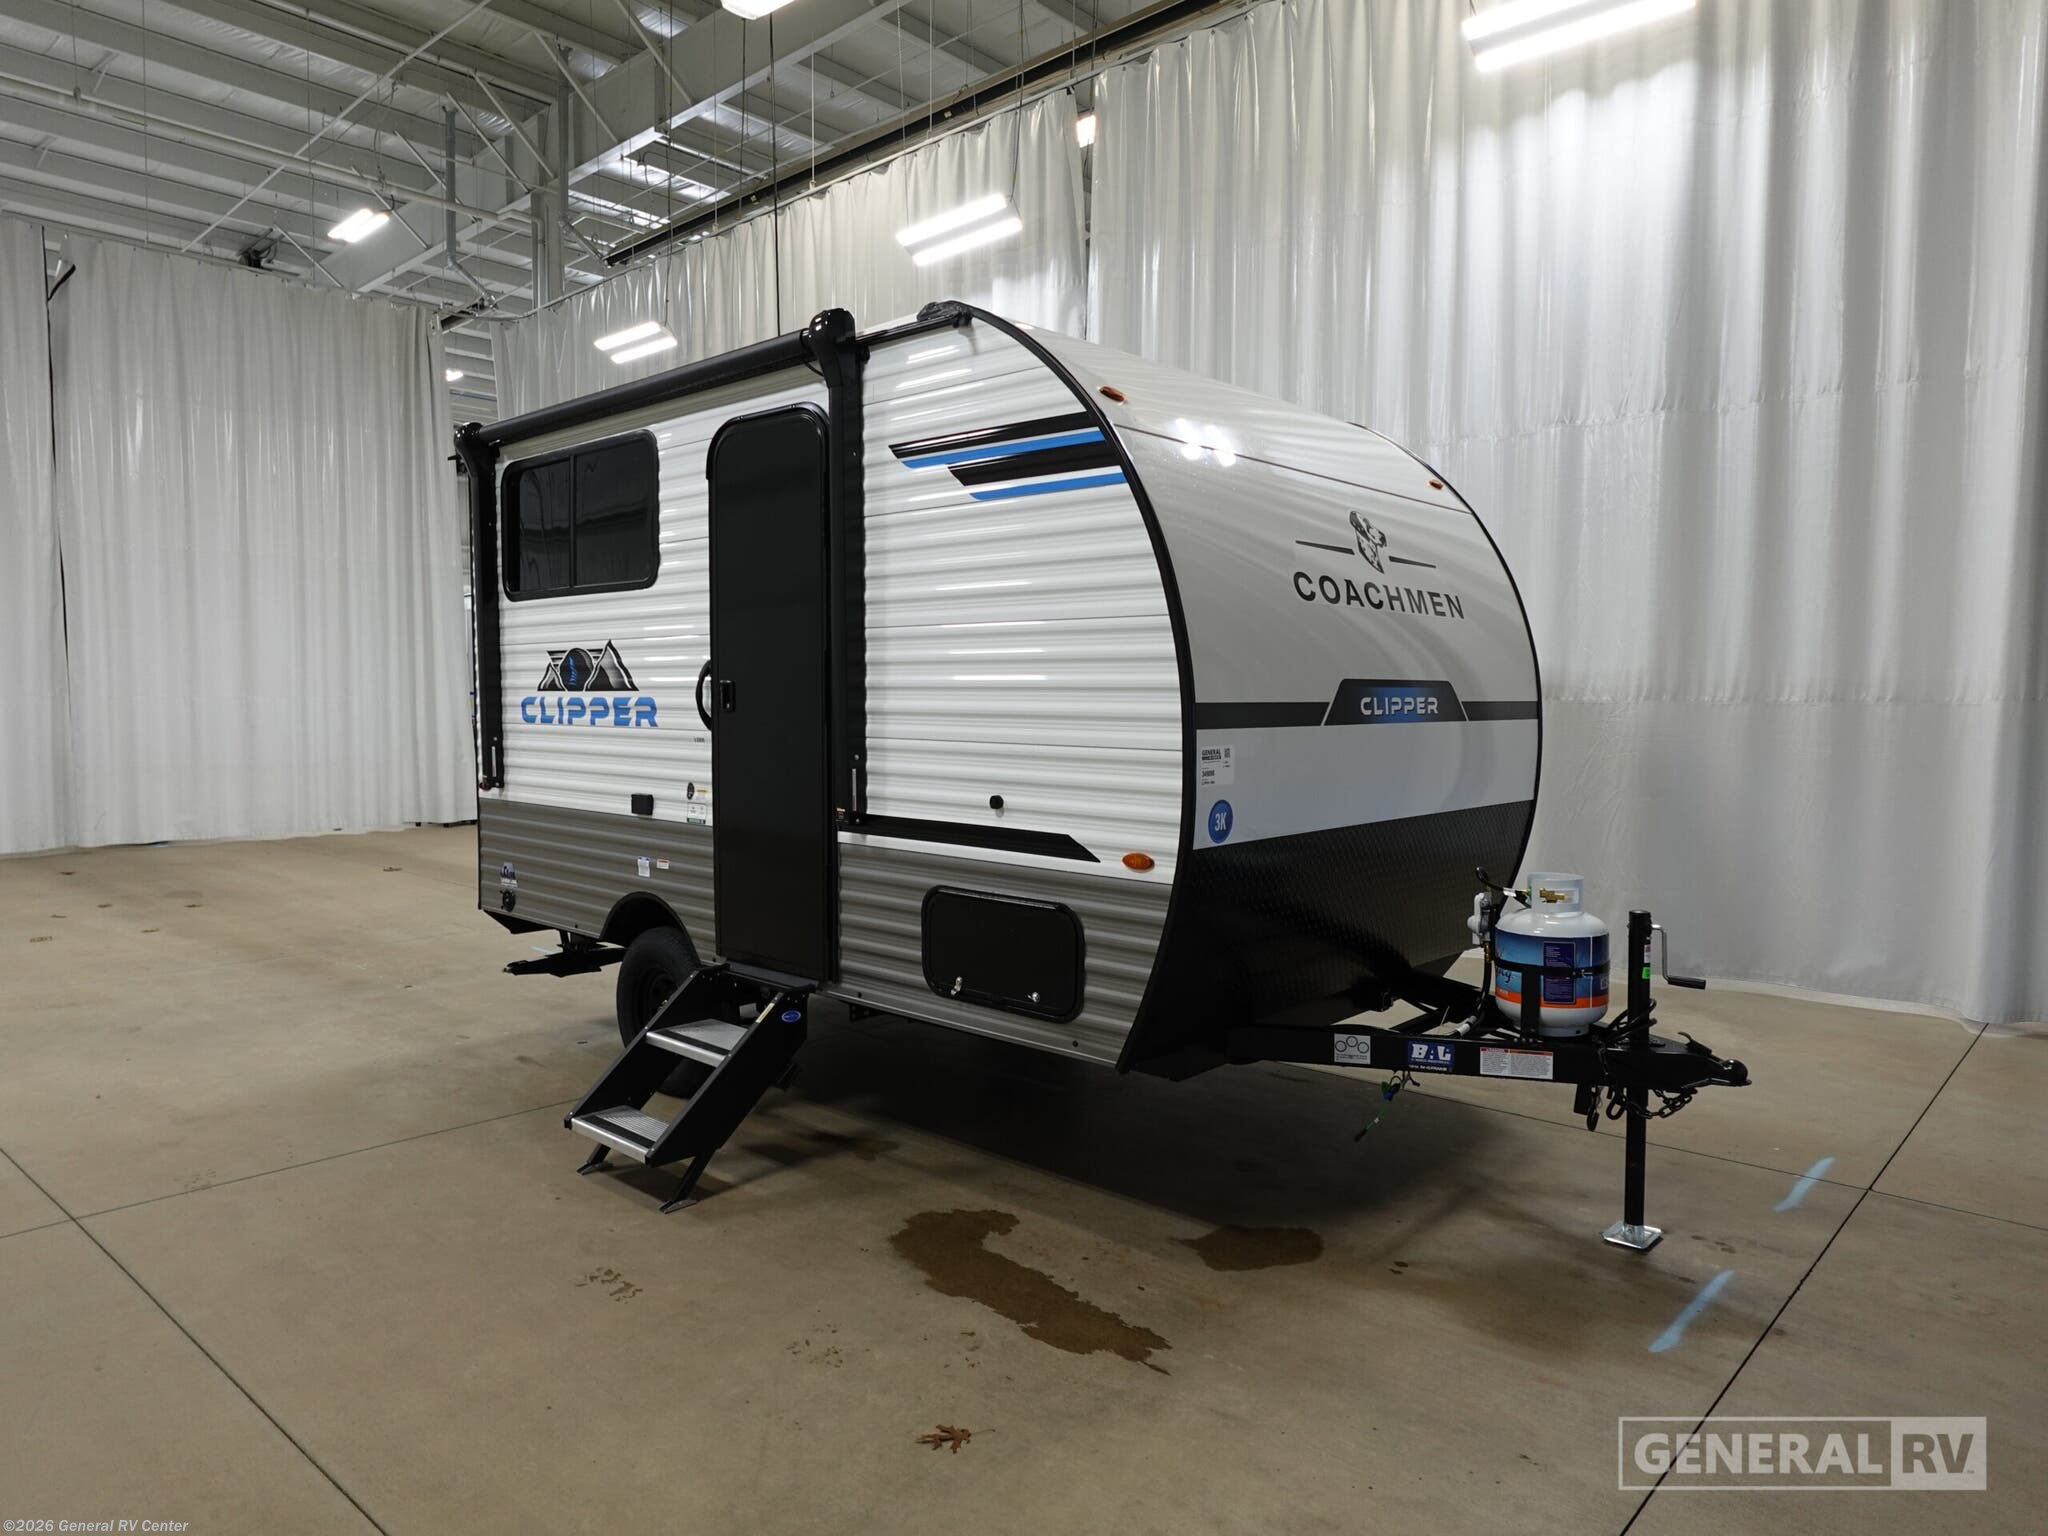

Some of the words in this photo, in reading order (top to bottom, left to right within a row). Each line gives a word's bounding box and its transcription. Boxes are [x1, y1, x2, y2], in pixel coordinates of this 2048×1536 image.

[1293, 571, 1465, 620] COACHMEN
[520, 696, 659, 727] CLIPPER
[1360, 696, 1439, 716] CLIPPER
[1215, 812, 1226, 831] 3K
